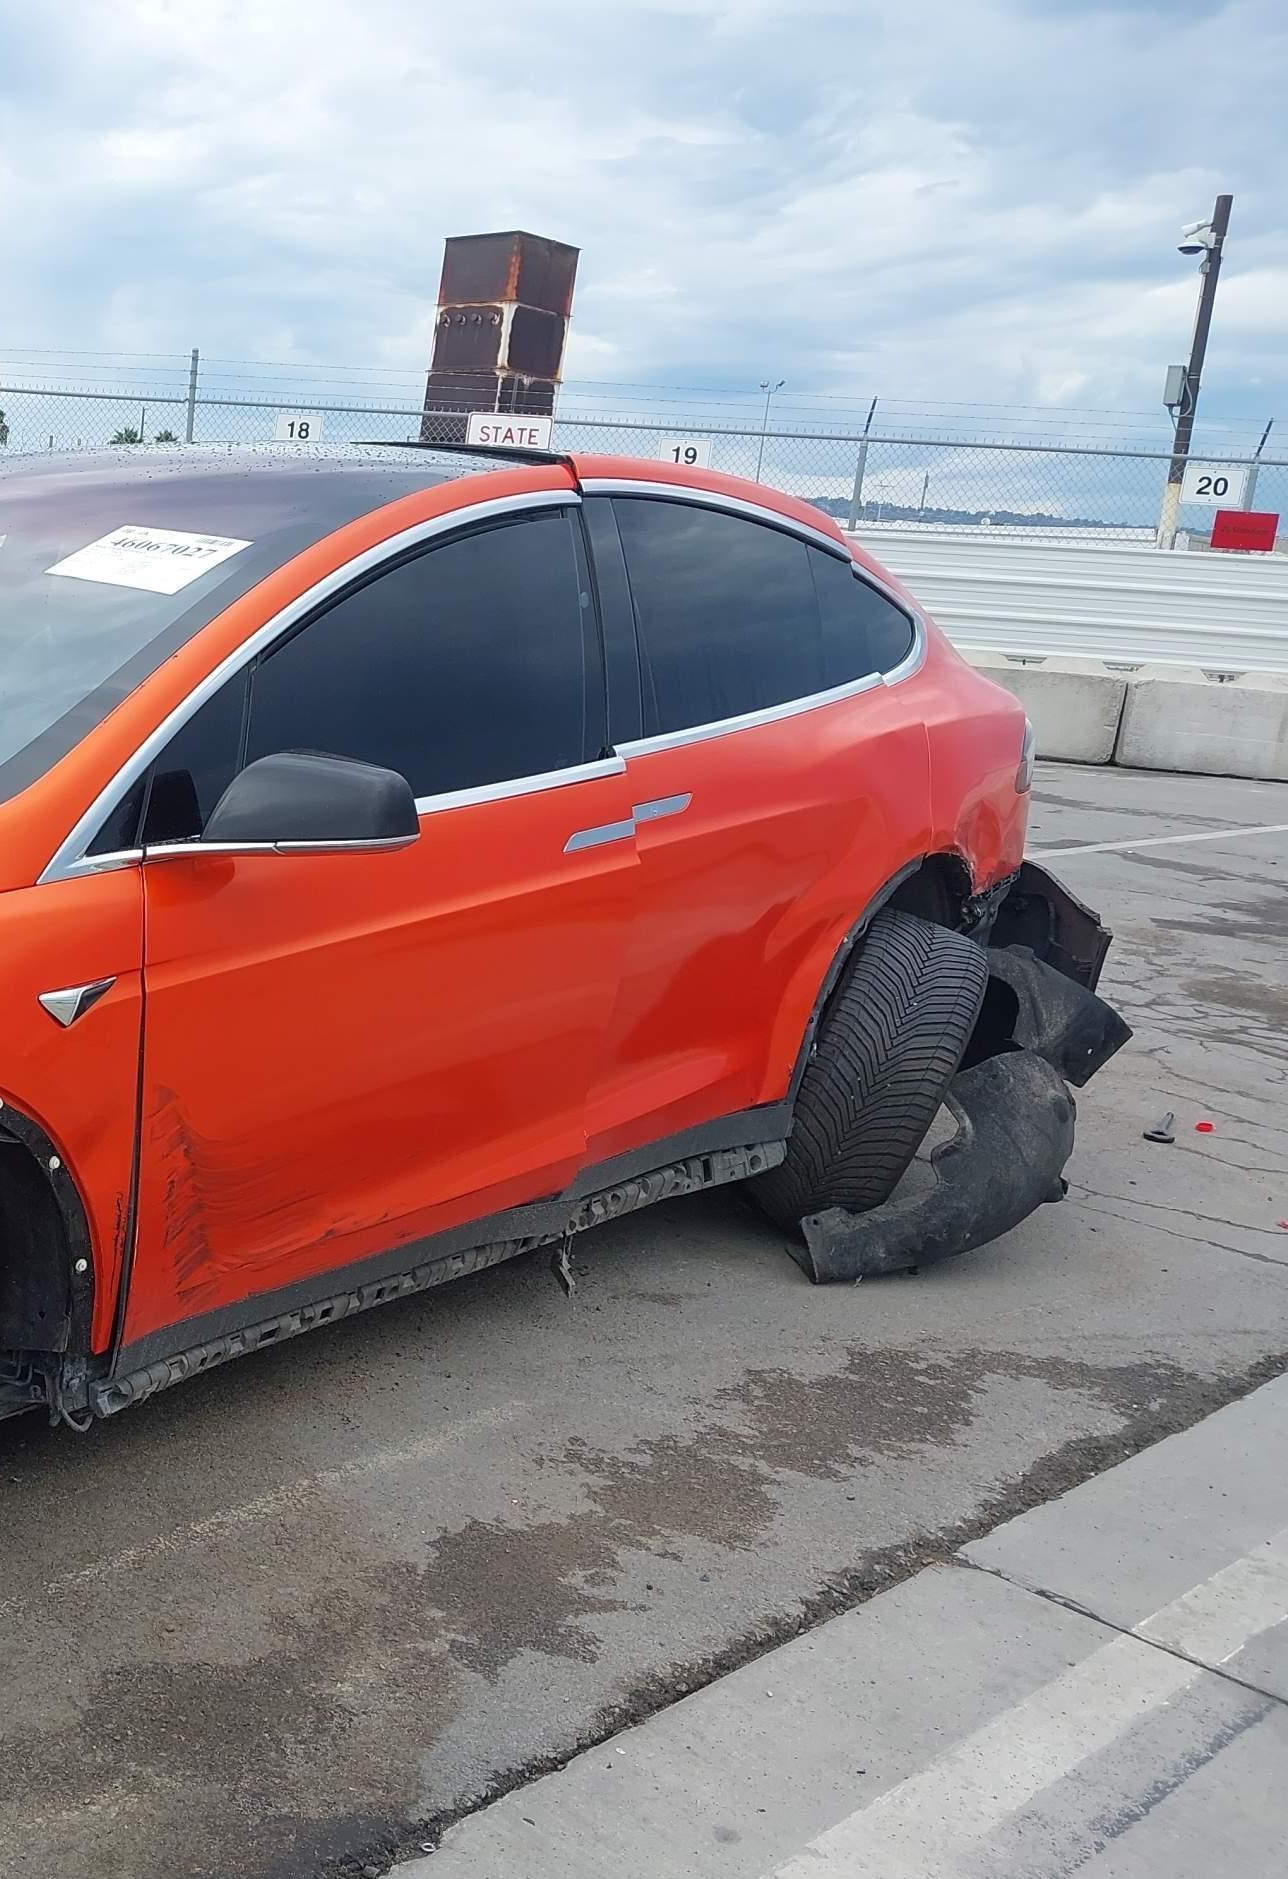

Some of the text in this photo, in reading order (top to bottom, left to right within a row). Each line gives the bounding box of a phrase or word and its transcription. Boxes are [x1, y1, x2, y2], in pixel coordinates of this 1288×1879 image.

[287, 421, 310, 439] 18
[479, 425, 540, 445] STATE
[672, 446, 697, 465] 19
[1195, 476, 1229, 496] 20
[110, 538, 218, 558] 46067027
